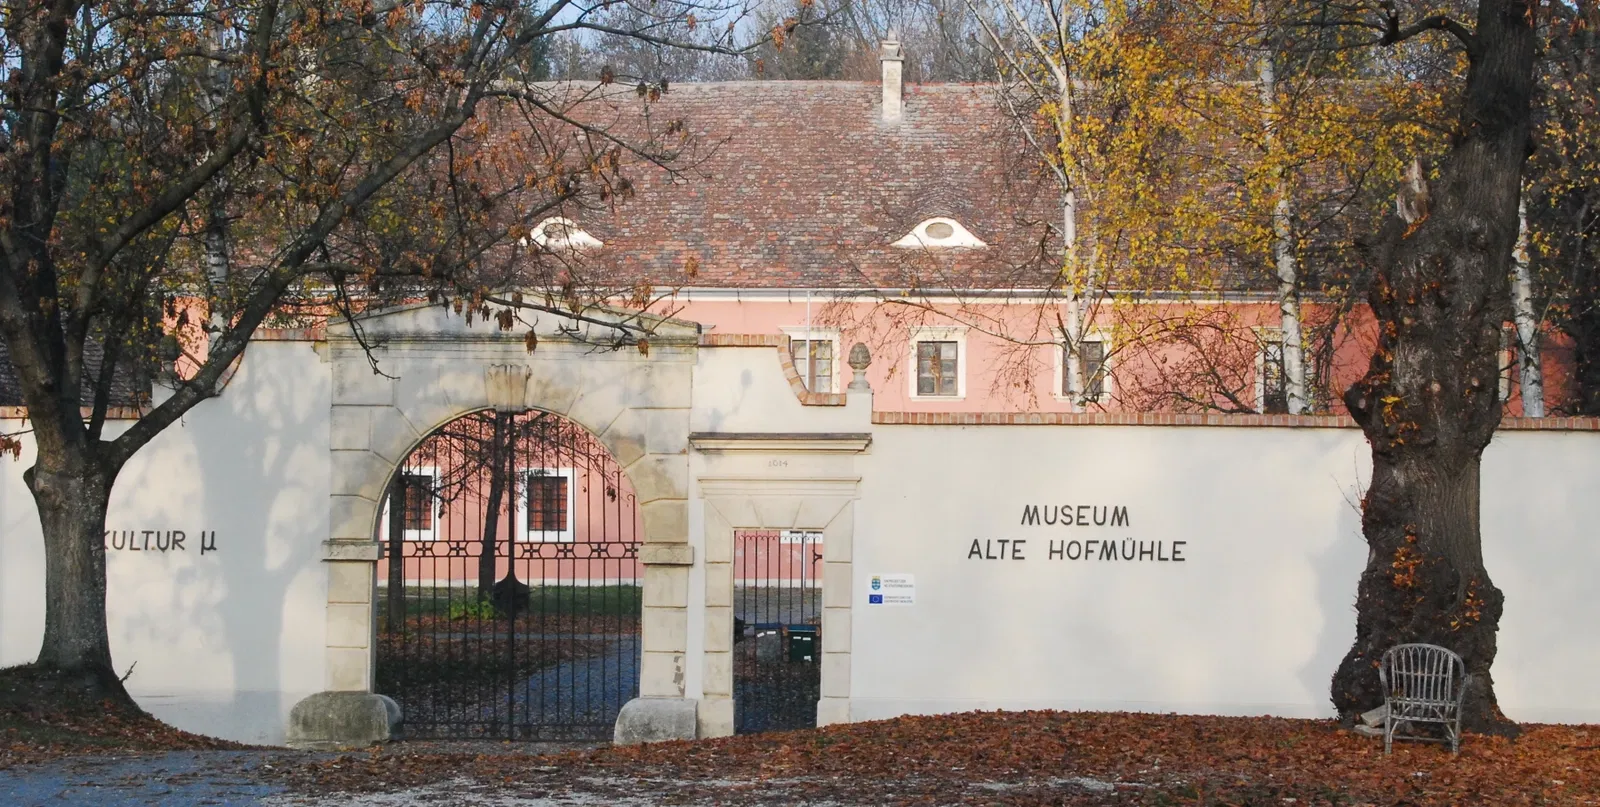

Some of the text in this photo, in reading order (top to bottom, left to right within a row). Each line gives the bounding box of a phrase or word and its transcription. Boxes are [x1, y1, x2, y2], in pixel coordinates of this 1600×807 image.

[1021, 504, 1130, 526] MUSEUM
[967, 538, 1187, 561] ALTE HOFMÜHLE
